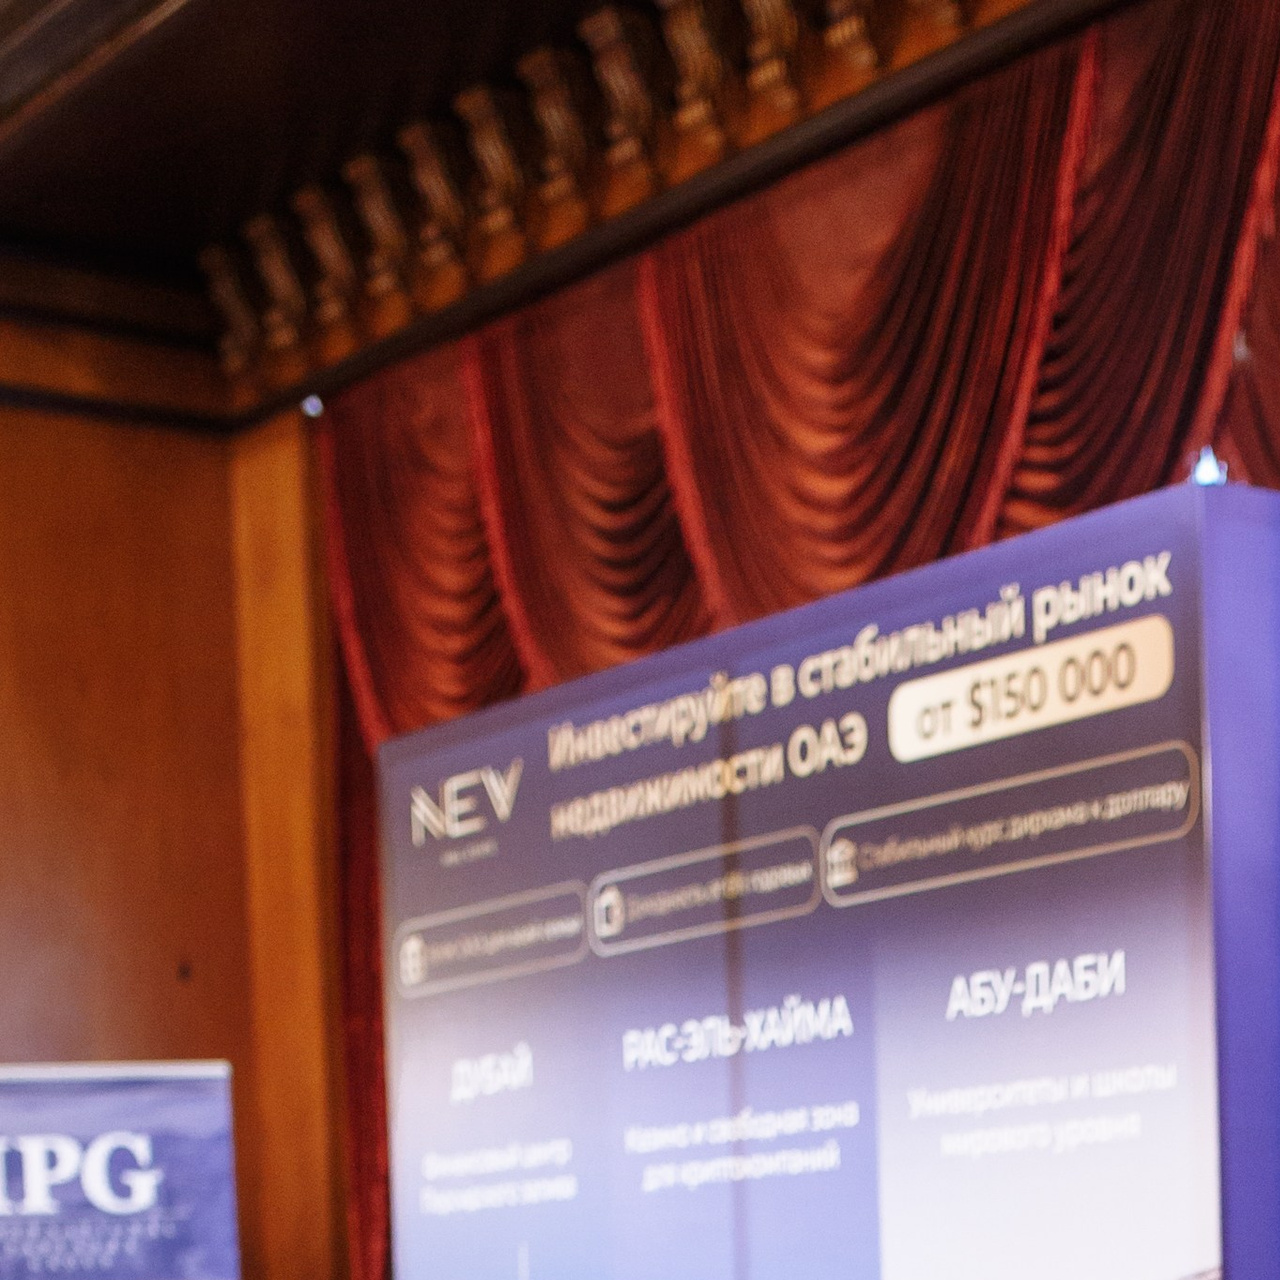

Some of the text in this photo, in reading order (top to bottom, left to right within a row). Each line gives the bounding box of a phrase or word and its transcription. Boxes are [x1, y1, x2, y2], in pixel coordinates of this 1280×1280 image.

[548, 551, 1173, 772] Инвестируйте в стабильный рынок
[969, 667, 1049, 729] $150
[1057, 642, 1139, 701] 000
[410, 758, 524, 847] NEV
[551, 710, 869, 840] недвижимости ОАЭ
[945, 948, 1127, 1022] АБУ-ДАБИ
[621, 993, 855, 1072] РАС-ЭЛЬ-ХАЙМА
